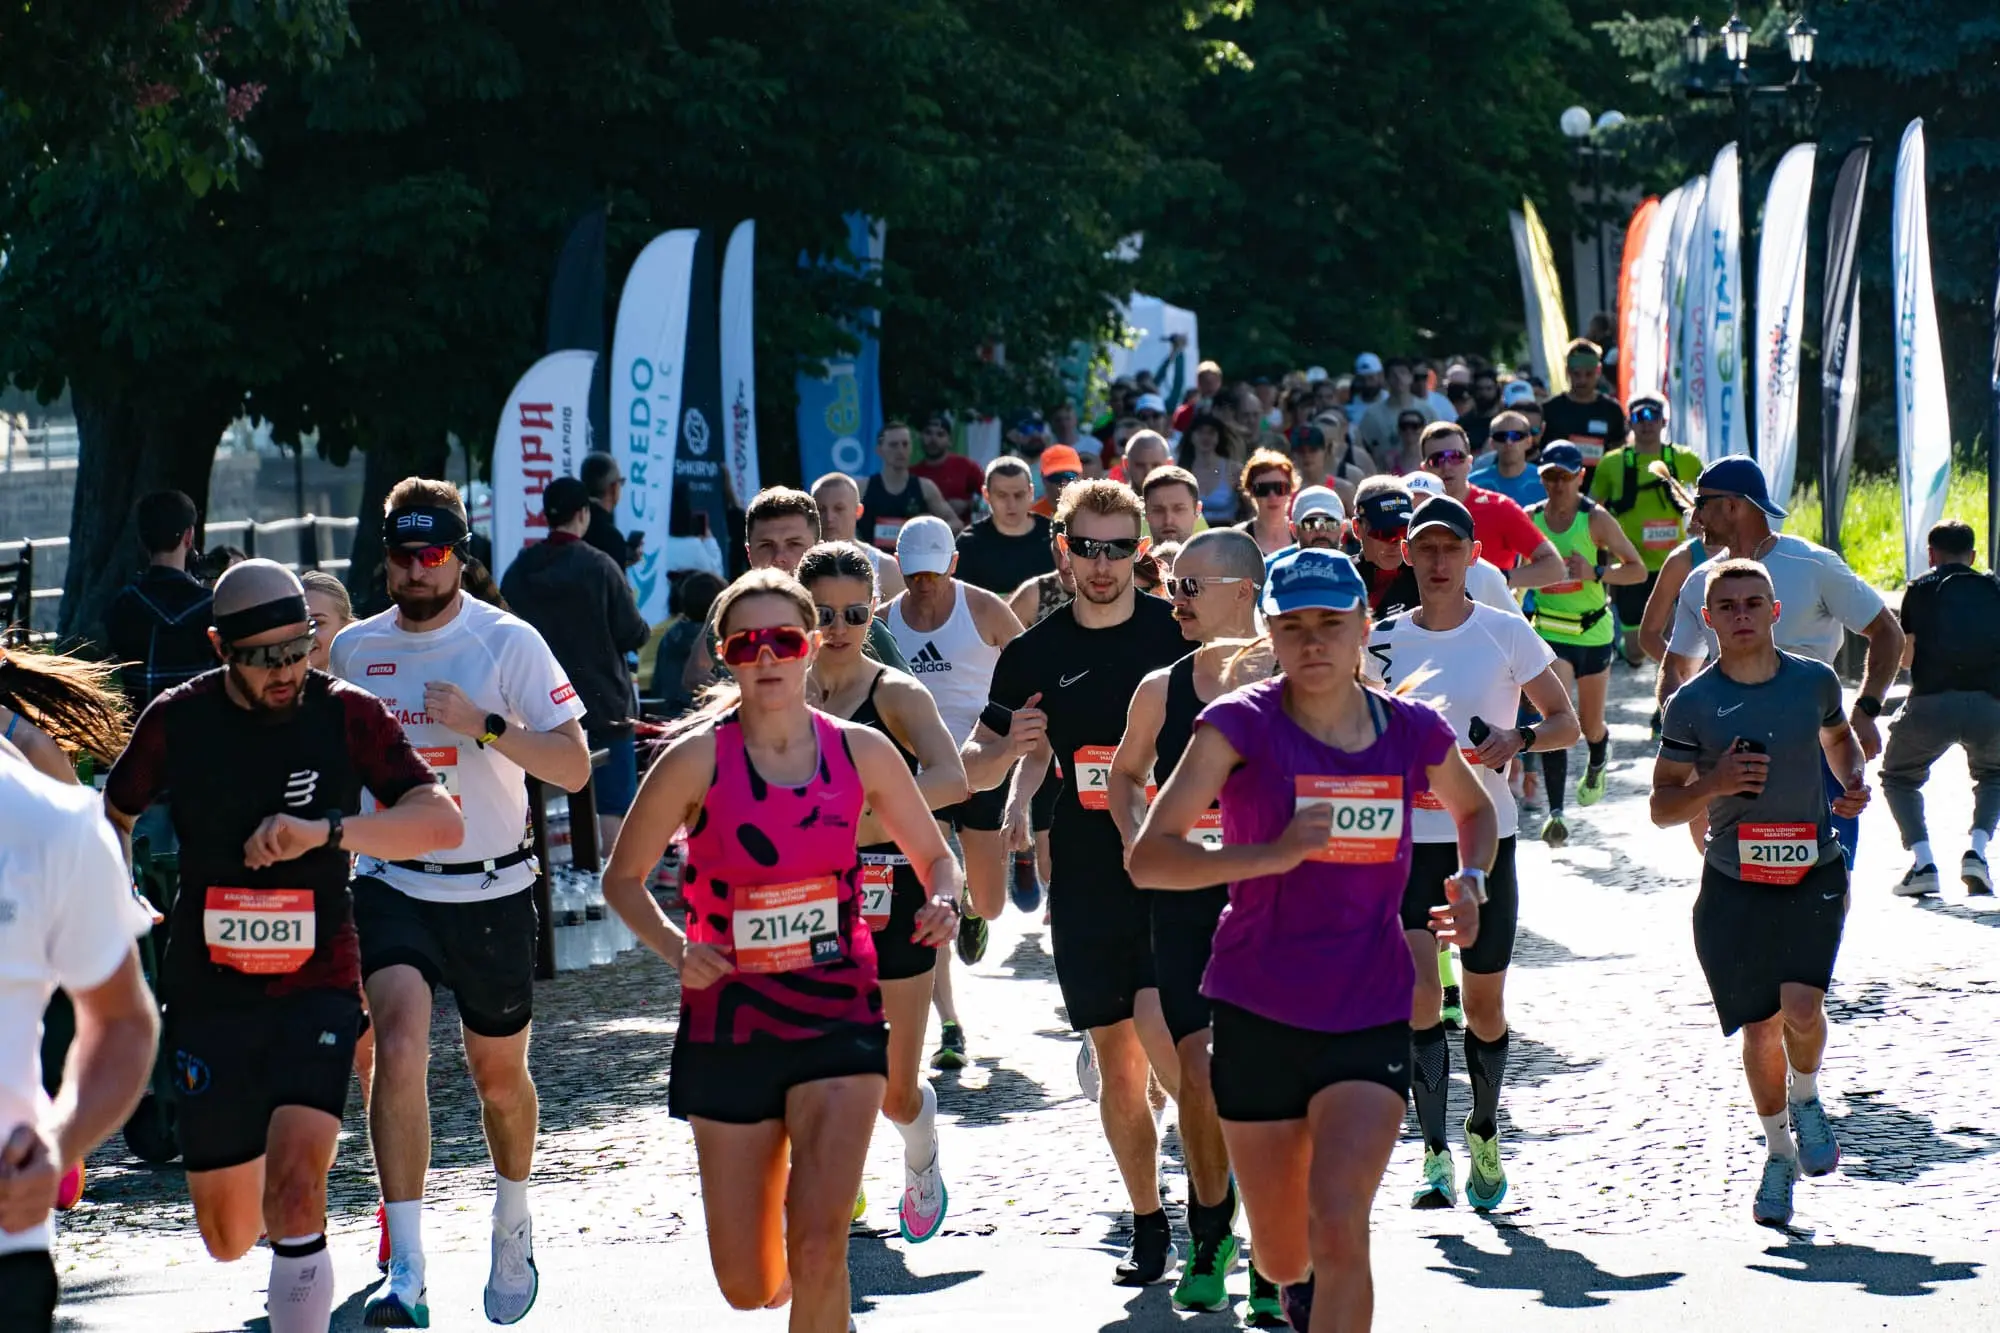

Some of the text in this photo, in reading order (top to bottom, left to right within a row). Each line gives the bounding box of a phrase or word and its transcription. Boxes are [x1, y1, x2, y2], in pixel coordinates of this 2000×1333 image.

[630, 357, 654, 519] CREDO
[518, 402, 553, 548] КУРА
[1407, 479, 1429, 488] USA
[1750, 845, 1809, 862] 21120
[219, 918, 302, 942] 21081
[748, 908, 827, 941] 21142
[816, 940, 839, 954] 575
